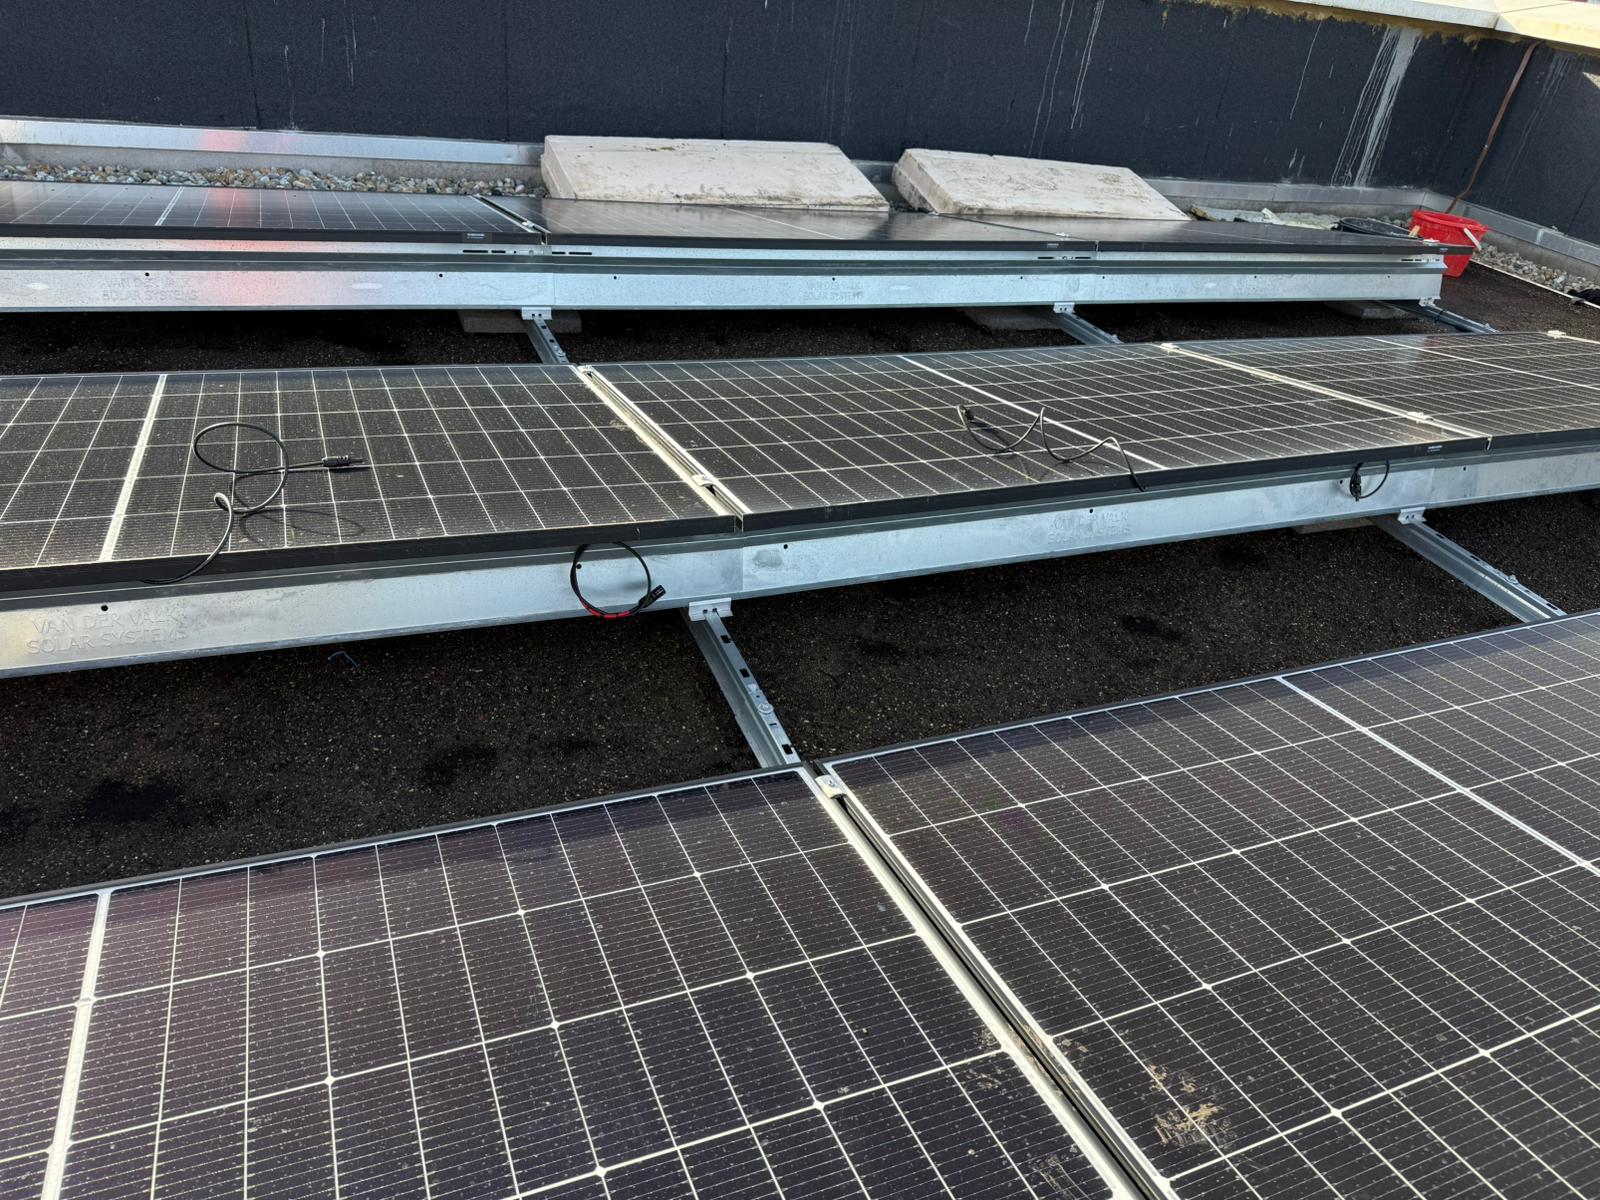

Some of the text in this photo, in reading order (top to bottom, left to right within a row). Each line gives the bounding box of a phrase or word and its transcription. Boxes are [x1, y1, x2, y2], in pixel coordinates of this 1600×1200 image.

[32, 617, 75, 634] VAN
[84, 612, 121, 630] DER
[26, 628, 189, 655] SOLAR SYSTEMS
